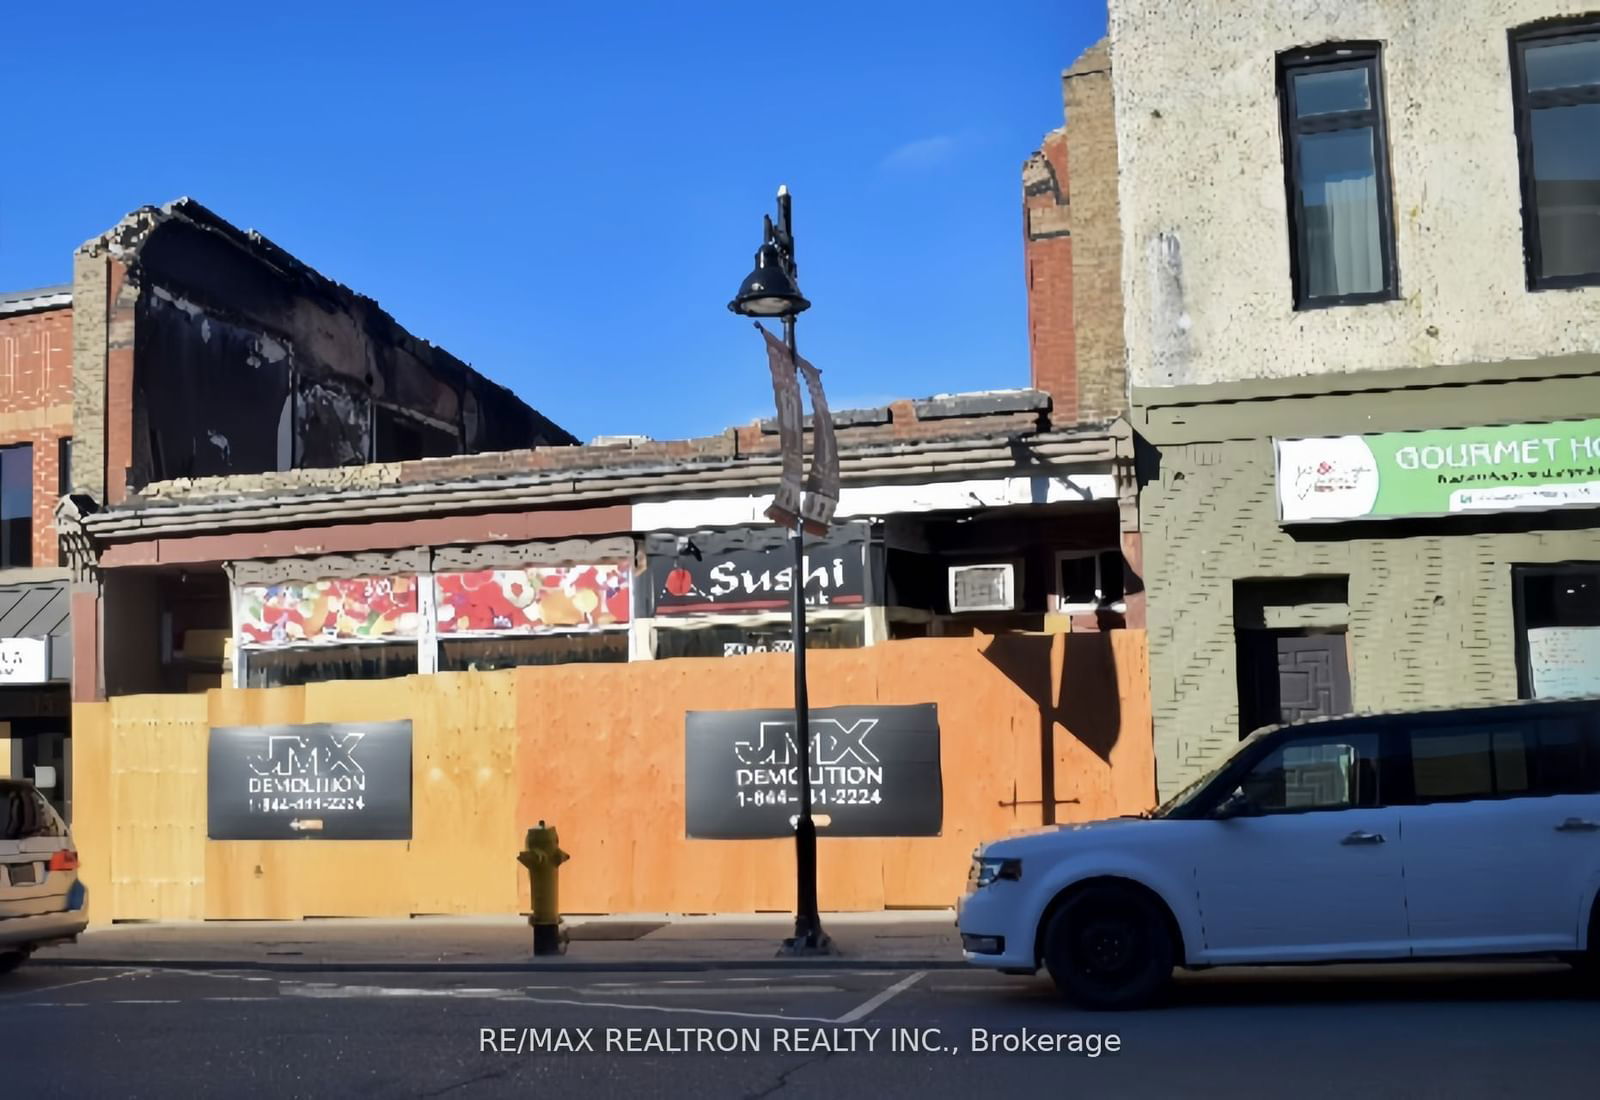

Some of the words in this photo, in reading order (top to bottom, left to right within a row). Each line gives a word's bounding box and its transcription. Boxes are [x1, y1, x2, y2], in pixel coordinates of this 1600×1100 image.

[1395, 438, 1561, 470] GOURMET
[710, 555, 843, 597] Sushi
[248, 732, 366, 776] JMX
[735, 718, 880, 765] JMX
